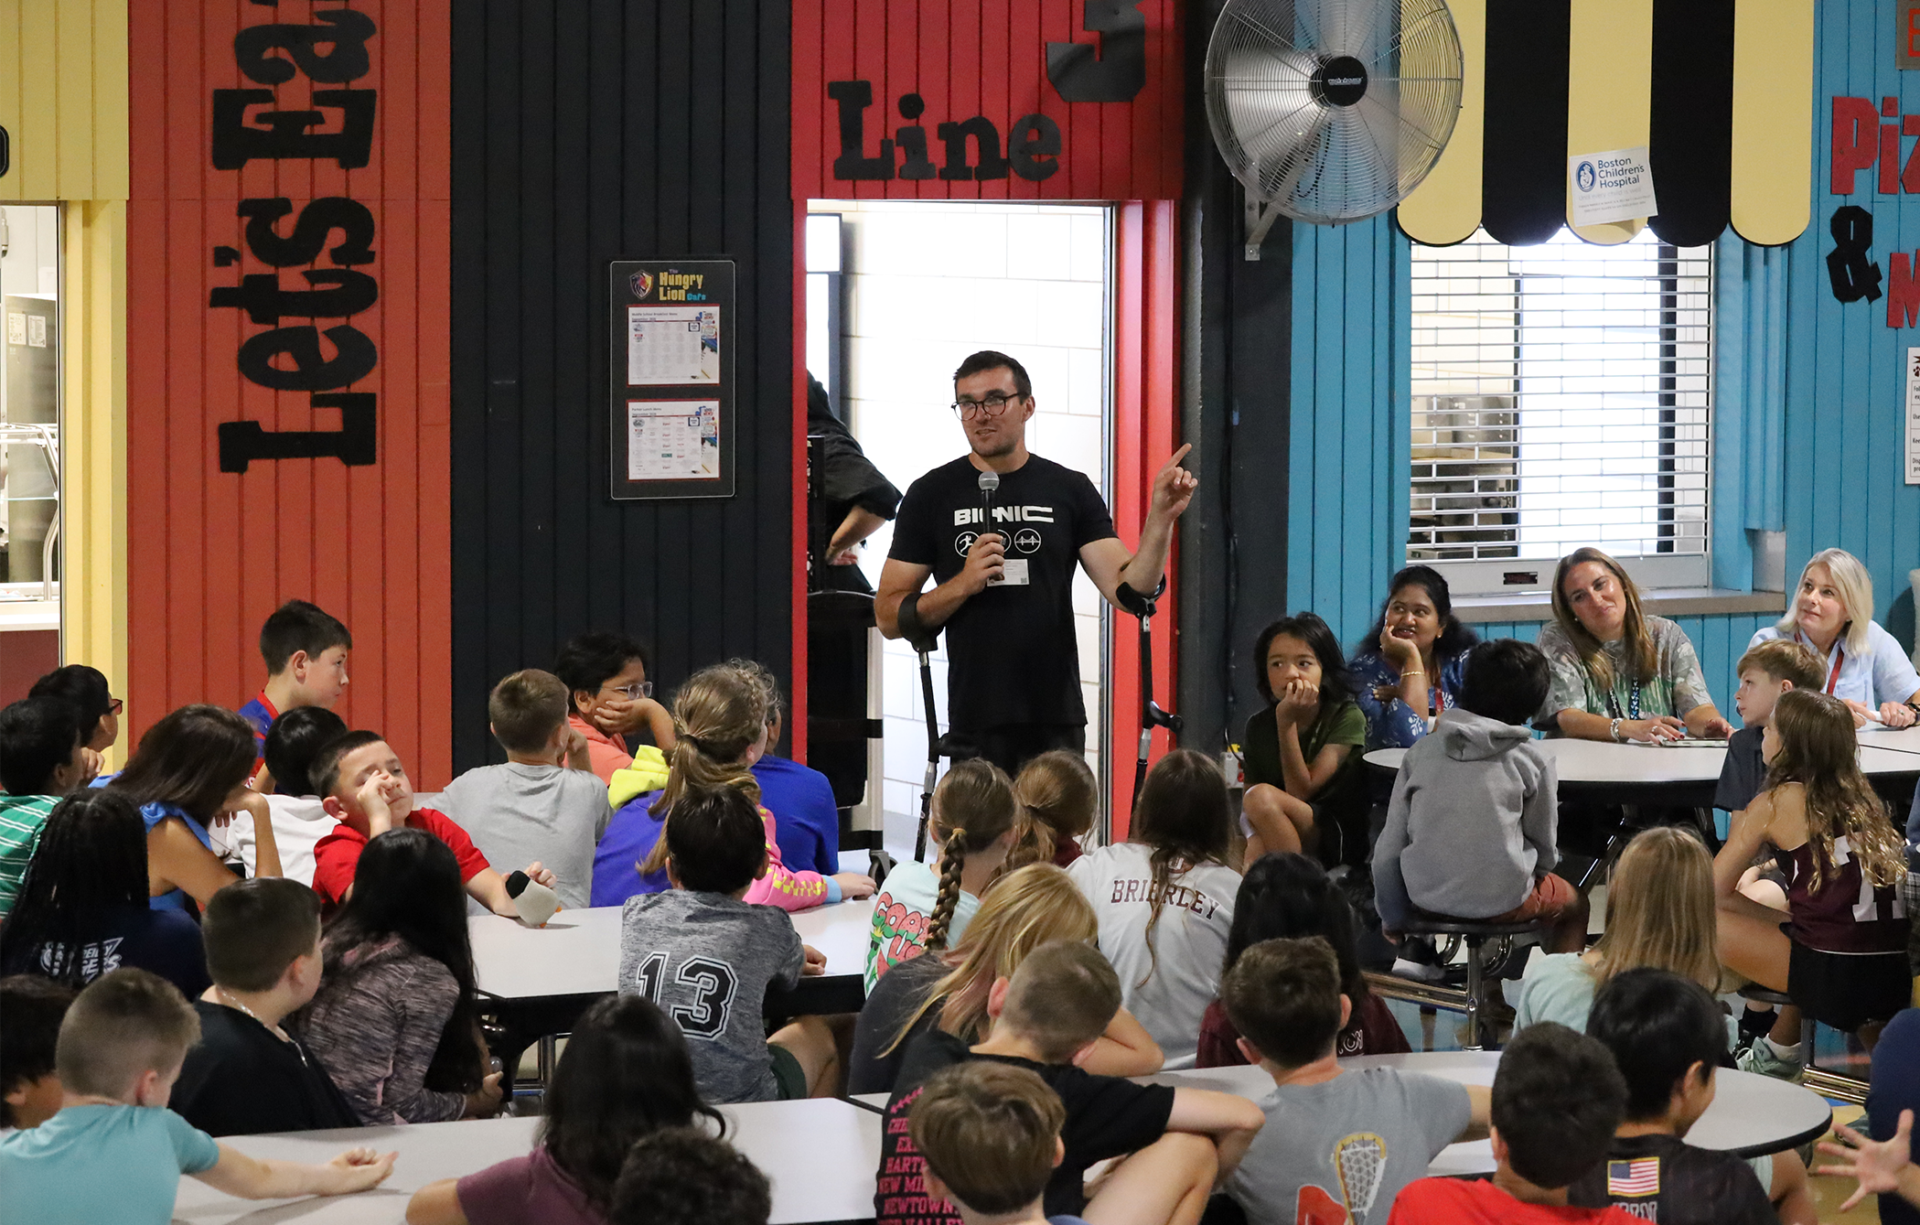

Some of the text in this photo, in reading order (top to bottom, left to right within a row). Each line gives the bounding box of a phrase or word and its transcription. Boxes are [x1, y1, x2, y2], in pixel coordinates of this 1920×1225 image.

[828, 80, 1062, 181] Line
[1598, 157, 1631, 169] Boston
[1598, 164, 1645, 179] Children's
[1600, 175, 1640, 189] Hospital
[209, 0, 378, 475] Let's Ea
[1826, 205, 1882, 304] &
[659, 271, 703, 290] Hungry
[659, 287, 686, 301] Lion
[636, 951, 739, 1041] 13
